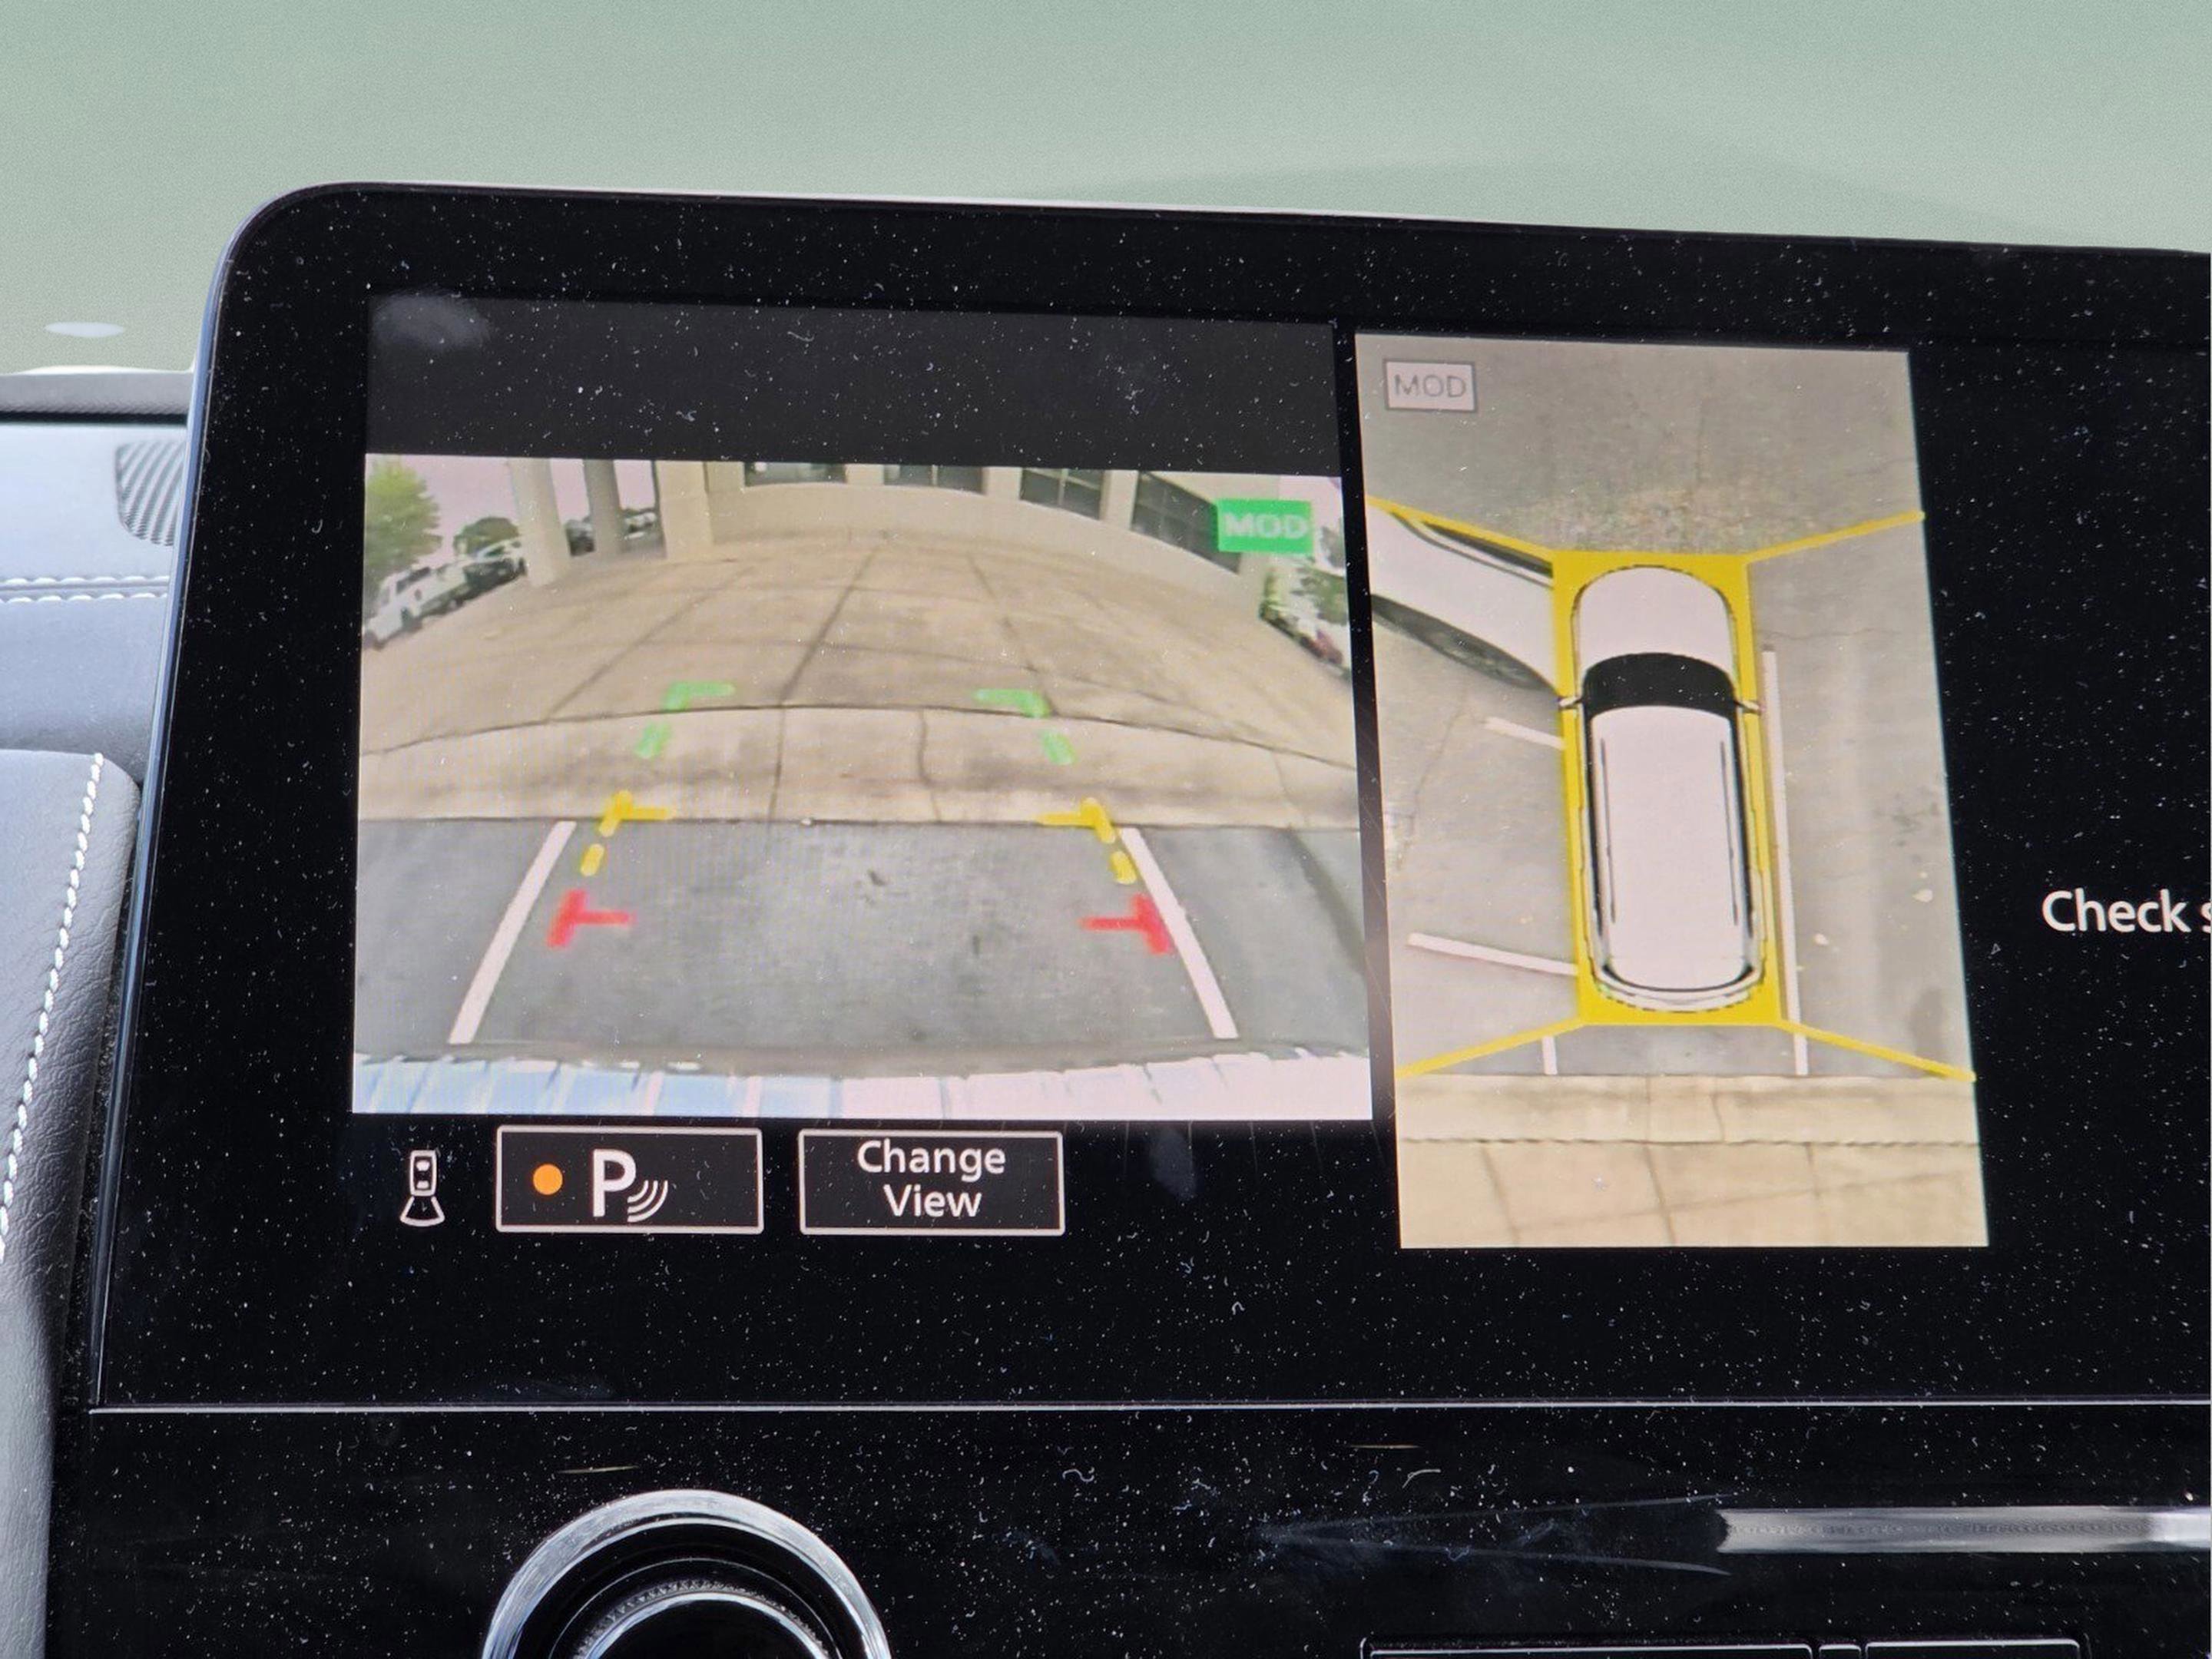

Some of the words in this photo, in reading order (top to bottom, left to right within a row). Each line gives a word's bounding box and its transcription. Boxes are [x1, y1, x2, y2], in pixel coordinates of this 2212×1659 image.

[1394, 373, 1466, 399] MOD
[1224, 514, 1305, 539] MOD
[2041, 887, 2192, 932] Check
[856, 1138, 1007, 1182] Change
[883, 1184, 982, 1218] View
